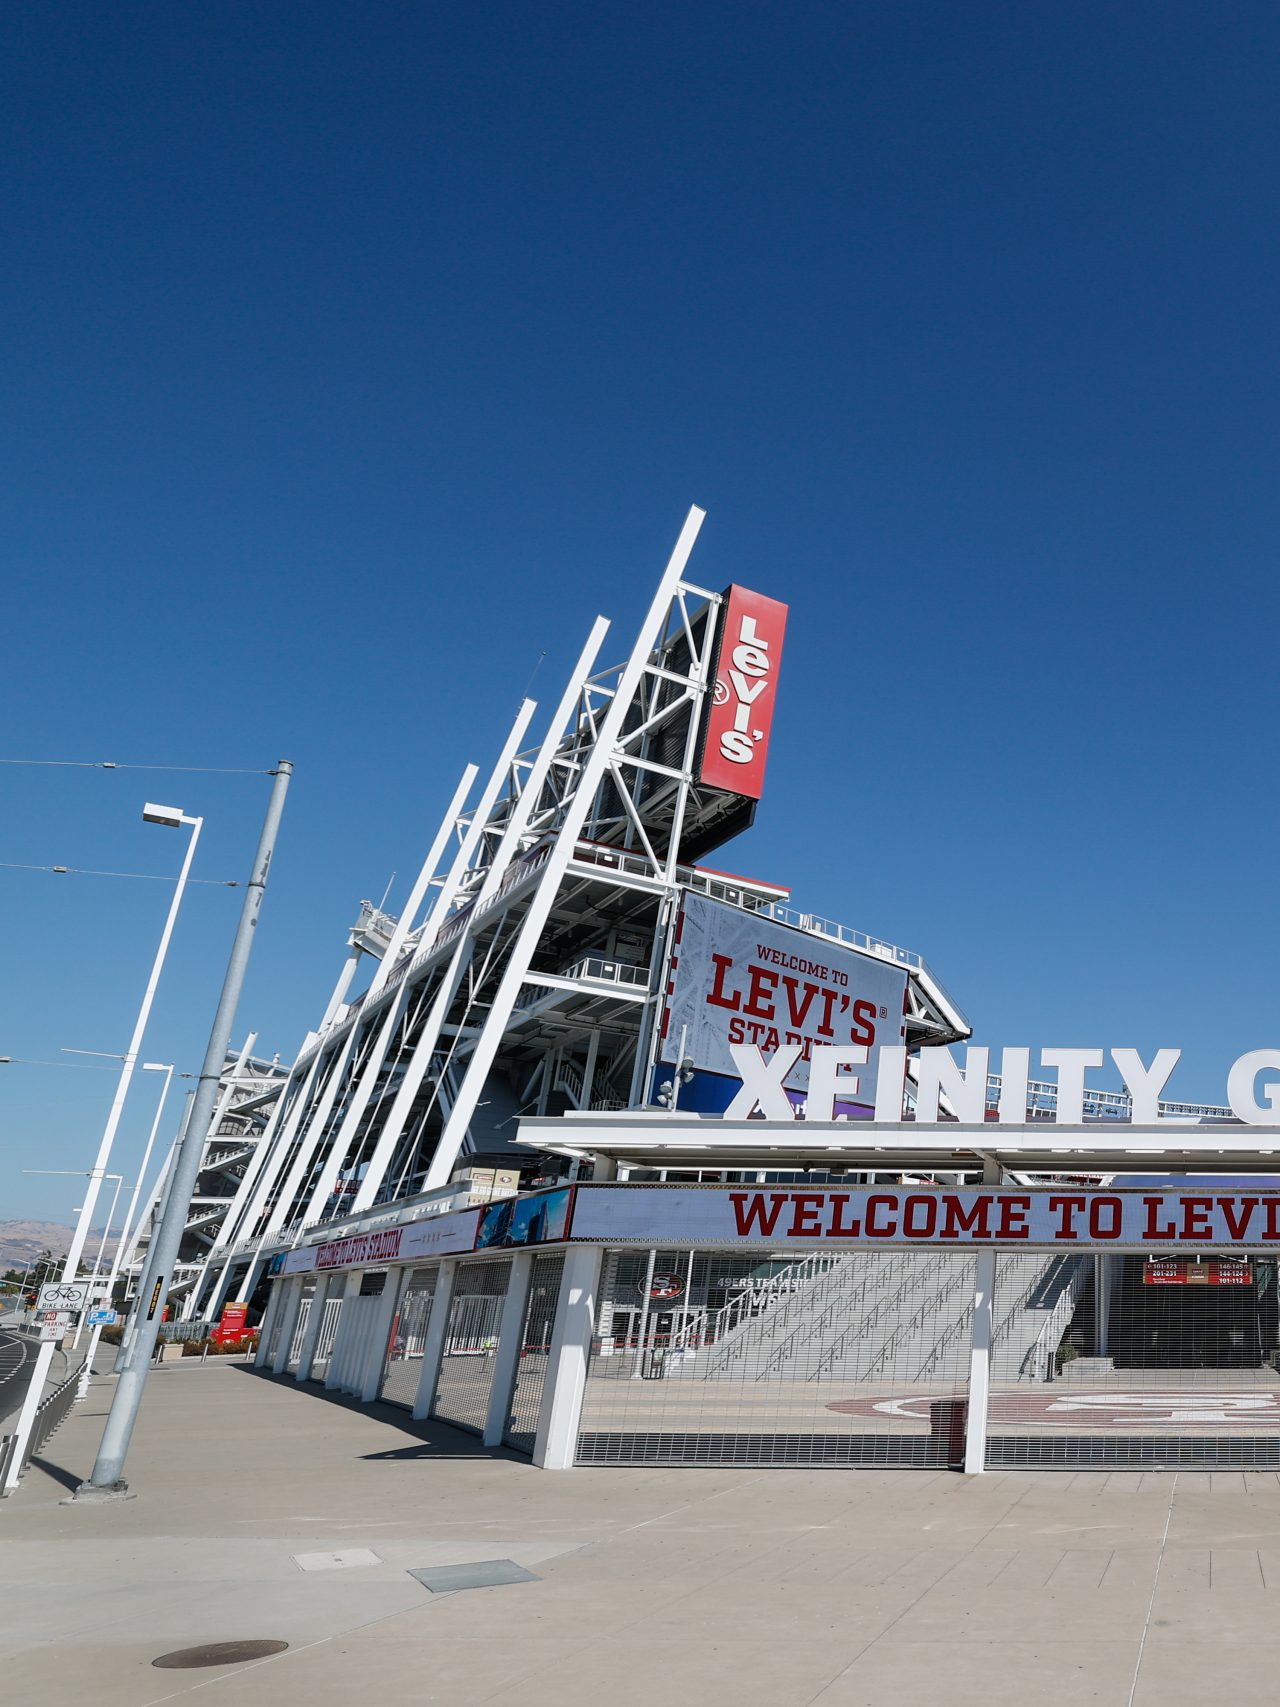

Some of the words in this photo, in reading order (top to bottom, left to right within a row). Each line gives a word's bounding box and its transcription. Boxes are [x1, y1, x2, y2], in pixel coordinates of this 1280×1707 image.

[756, 944, 829, 980] WELCOME
[832, 970, 848, 987] TO
[723, 1044, 1181, 1125] XFINITY
[729, 1193, 1030, 1238] WELCOME
[1049, 1196, 1122, 1239] TO
[367, 1229, 404, 1261] STADIUM
[717, 1278, 754, 1287] 49ERS
[46, 1312, 56, 1320] NO
